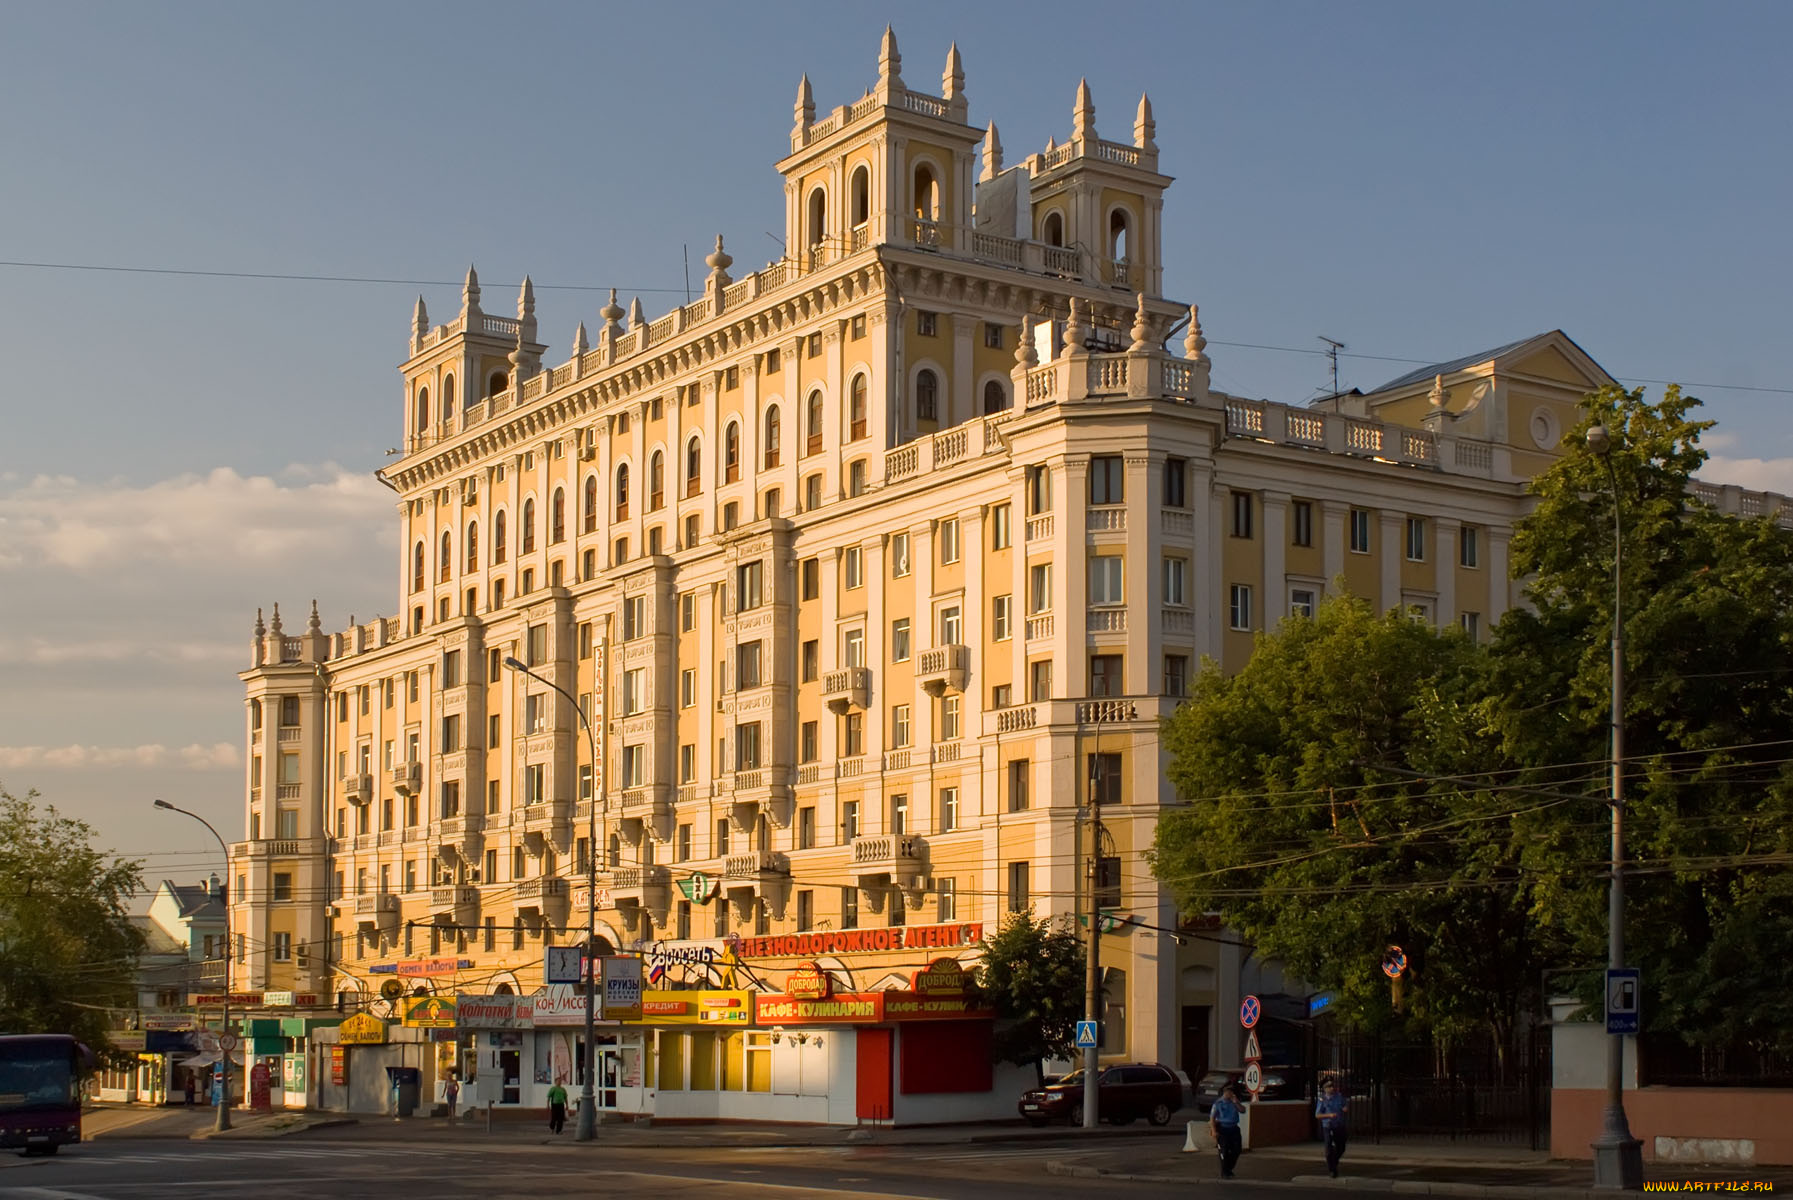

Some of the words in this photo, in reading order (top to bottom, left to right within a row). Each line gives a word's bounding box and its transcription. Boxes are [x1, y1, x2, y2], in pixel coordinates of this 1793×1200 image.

[723, 927, 902, 957] ЕЛЕЗНОДОРОЖНОЕ
[400, 965, 423, 974] ОБМЕН
[426, 962, 455, 973] ВАЛЮТЫ
[607, 979, 639, 990] КРУИЗЫ
[788, 978, 825, 992] ДОБРОДАР
[918, 975, 961, 991] ДОБРОД
[458, 1003, 513, 1019] Колготки
[642, 1002, 680, 1011] КРЕДИТ
[340, 1032, 358, 1041] ОБМЕН
[360, 1031, 381, 1041] ВАЛЮТЫ
[1247, 1070, 1258, 1083] 40
